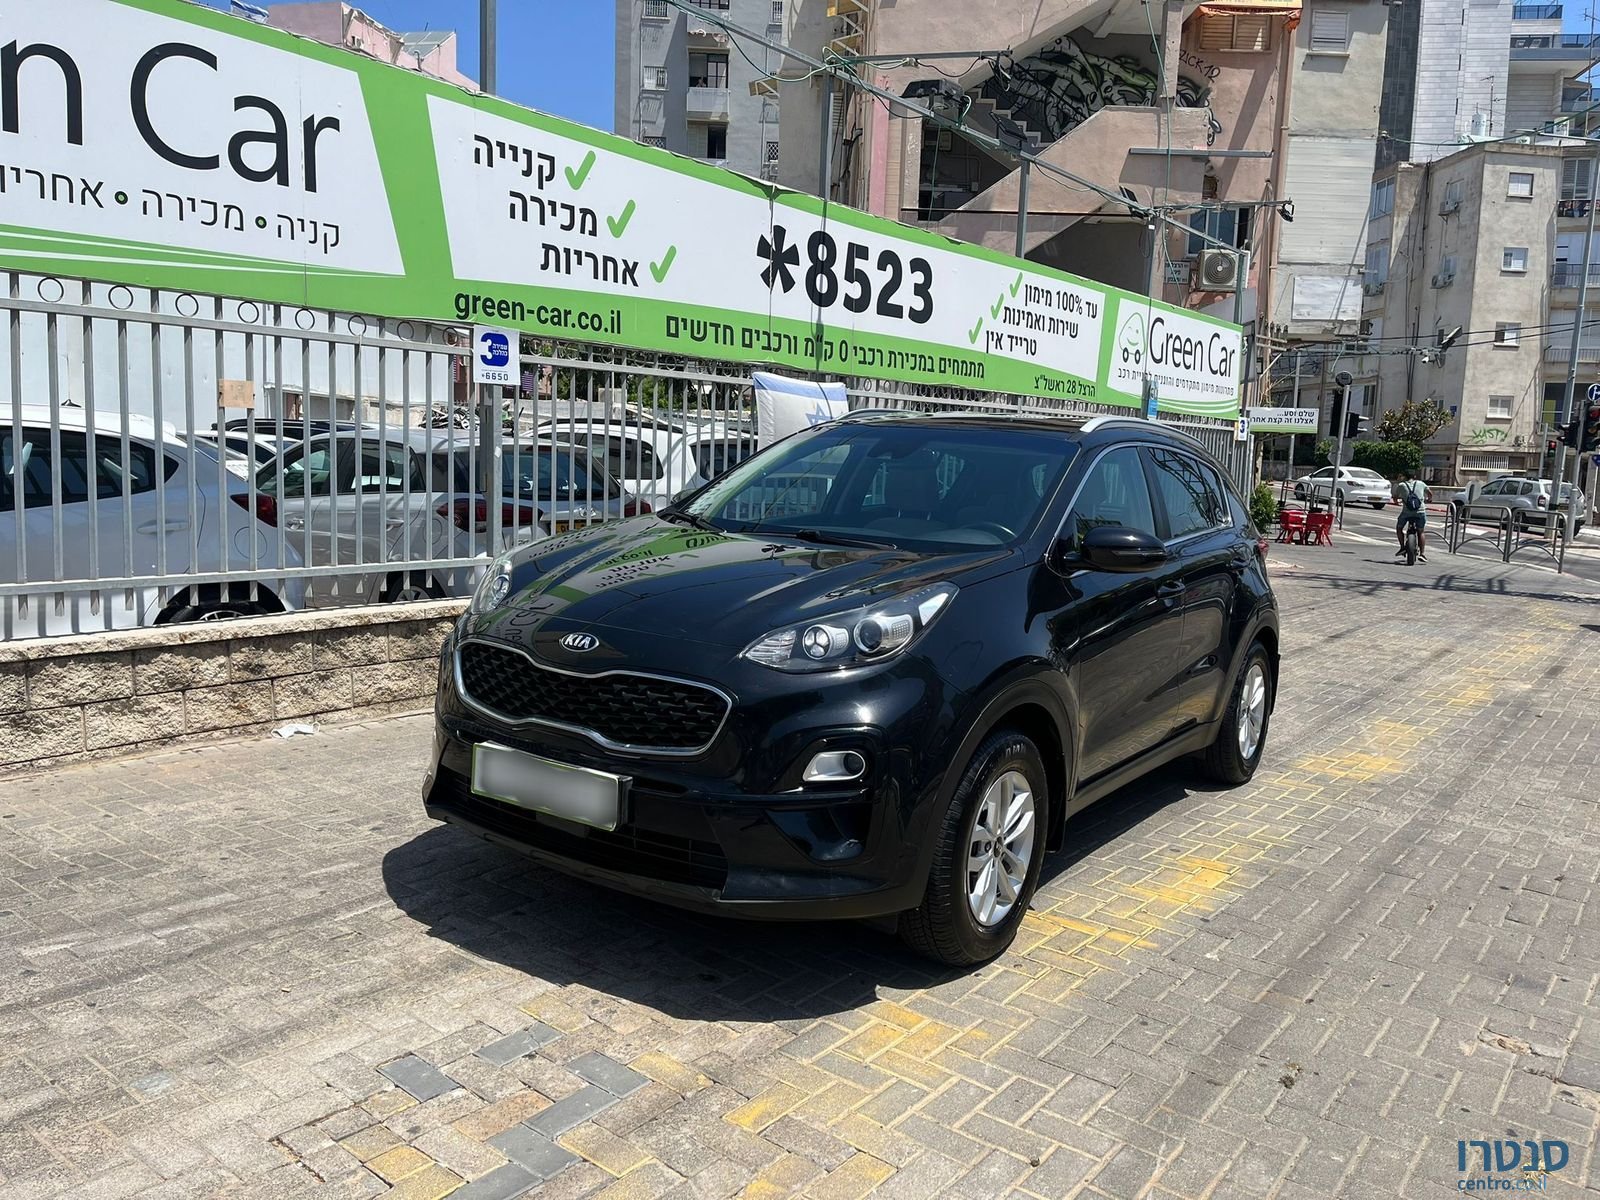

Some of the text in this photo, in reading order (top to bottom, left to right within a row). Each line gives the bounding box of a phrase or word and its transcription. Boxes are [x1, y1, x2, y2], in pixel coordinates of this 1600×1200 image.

[130, 42, 340, 193] Car
[474, 134, 556, 190] קנייה
[142, 189, 244, 232] מכירה
[509, 190, 597, 237] מכירה
[277, 214, 340, 254] קניה
[540, 243, 639, 287] אחריות
[454, 292, 621, 334] green-car.co.il
[1025, 284, 1098, 319] עד 100% מימון
[666, 315, 734, 346] חדשים
[1003, 306, 1079, 338] שירות ואמינות
[742, 328, 798, 355] ורכבים
[839, 340, 849, 362] 0
[986, 330, 1037, 356] טרייד אין
[1149, 317, 1235, 378] Green Car
[853, 346, 884, 367] רכבי
[888, 350, 934, 373] במכירת
[939, 357, 985, 378] מתמחים
[1066, 379, 1077, 394] 28
[1078, 380, 1096, 397] הרצל
[1267, 417, 1283, 425] קצת
[1299, 410, 1315, 418] שלם
[564, 633, 592, 649] KIA
